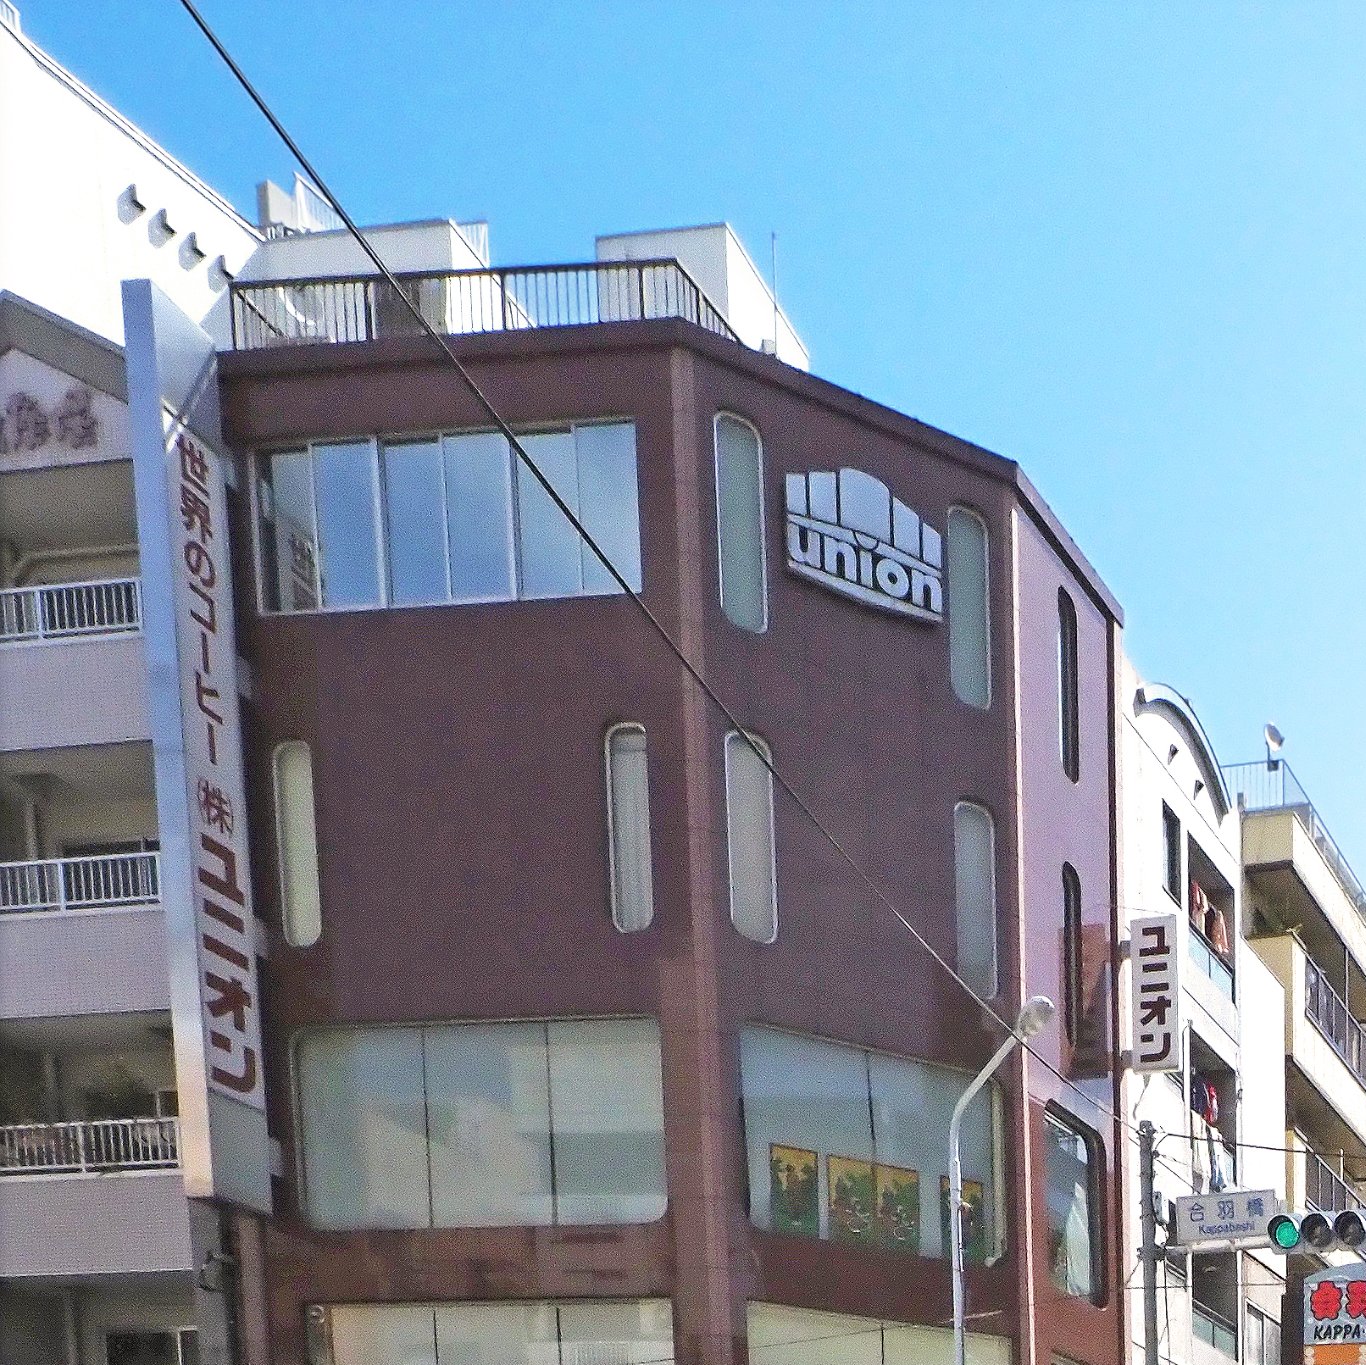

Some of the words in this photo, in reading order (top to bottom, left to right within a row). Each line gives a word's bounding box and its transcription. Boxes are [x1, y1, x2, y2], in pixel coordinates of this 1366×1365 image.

[788, 518, 943, 612] union
[1139, 925, 1172, 1064] ユニオン
